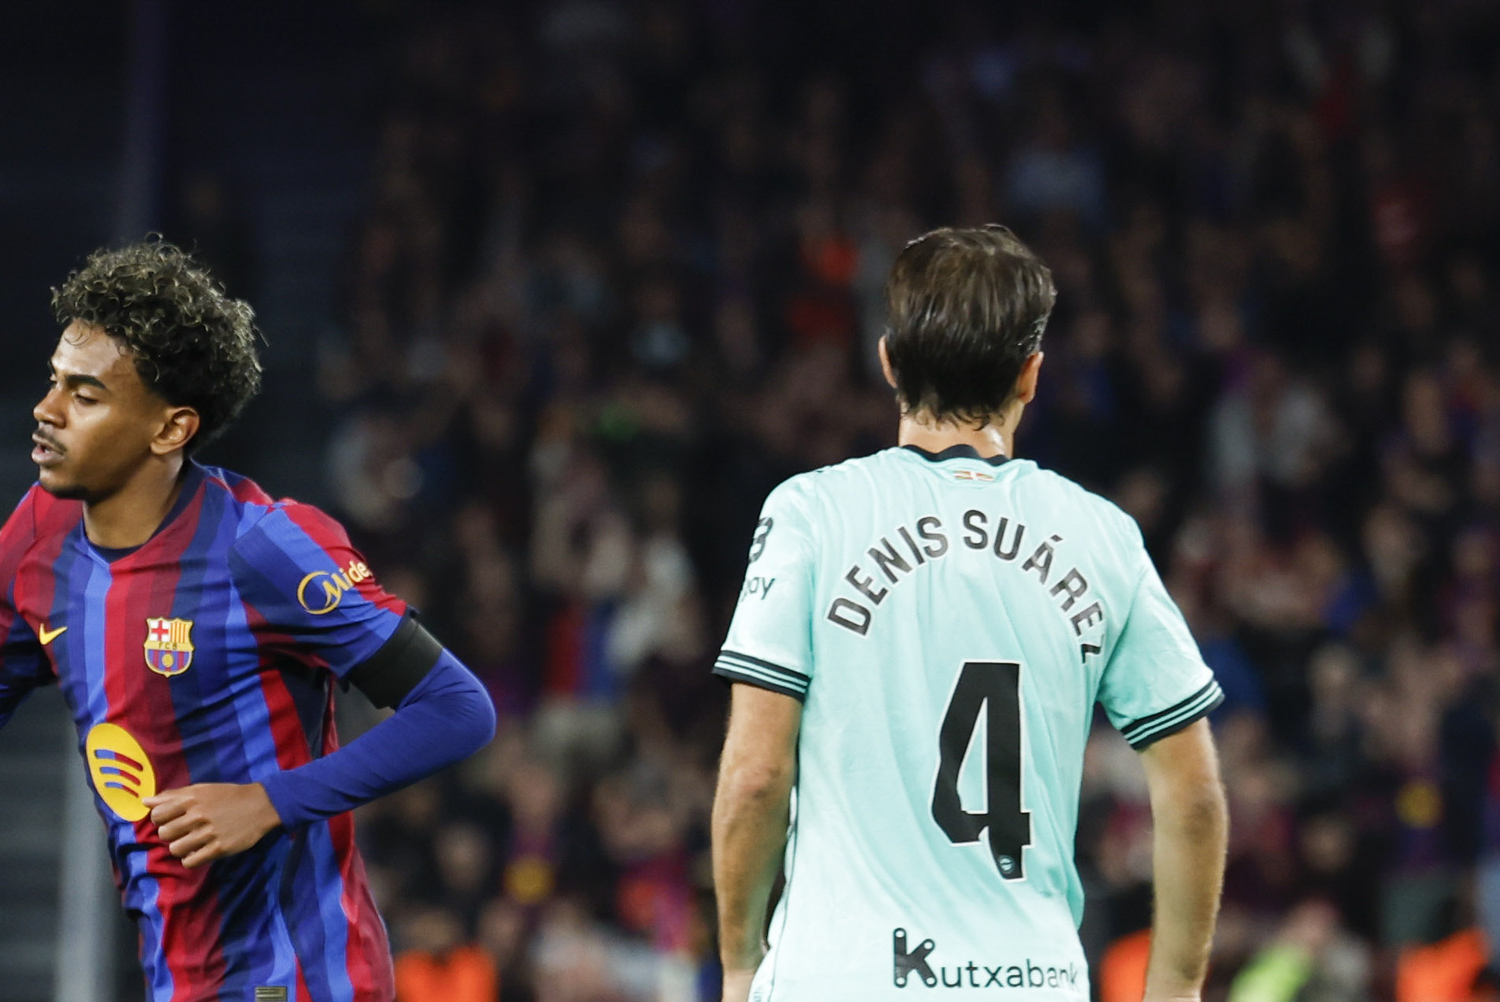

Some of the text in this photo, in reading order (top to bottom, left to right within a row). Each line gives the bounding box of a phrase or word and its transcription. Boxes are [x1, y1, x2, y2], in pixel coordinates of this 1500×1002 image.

[827, 509, 1105, 664] DENIS SUÁREZ
[930, 661, 1032, 880] 4
[893, 927, 1077, 988] Kutxabank
